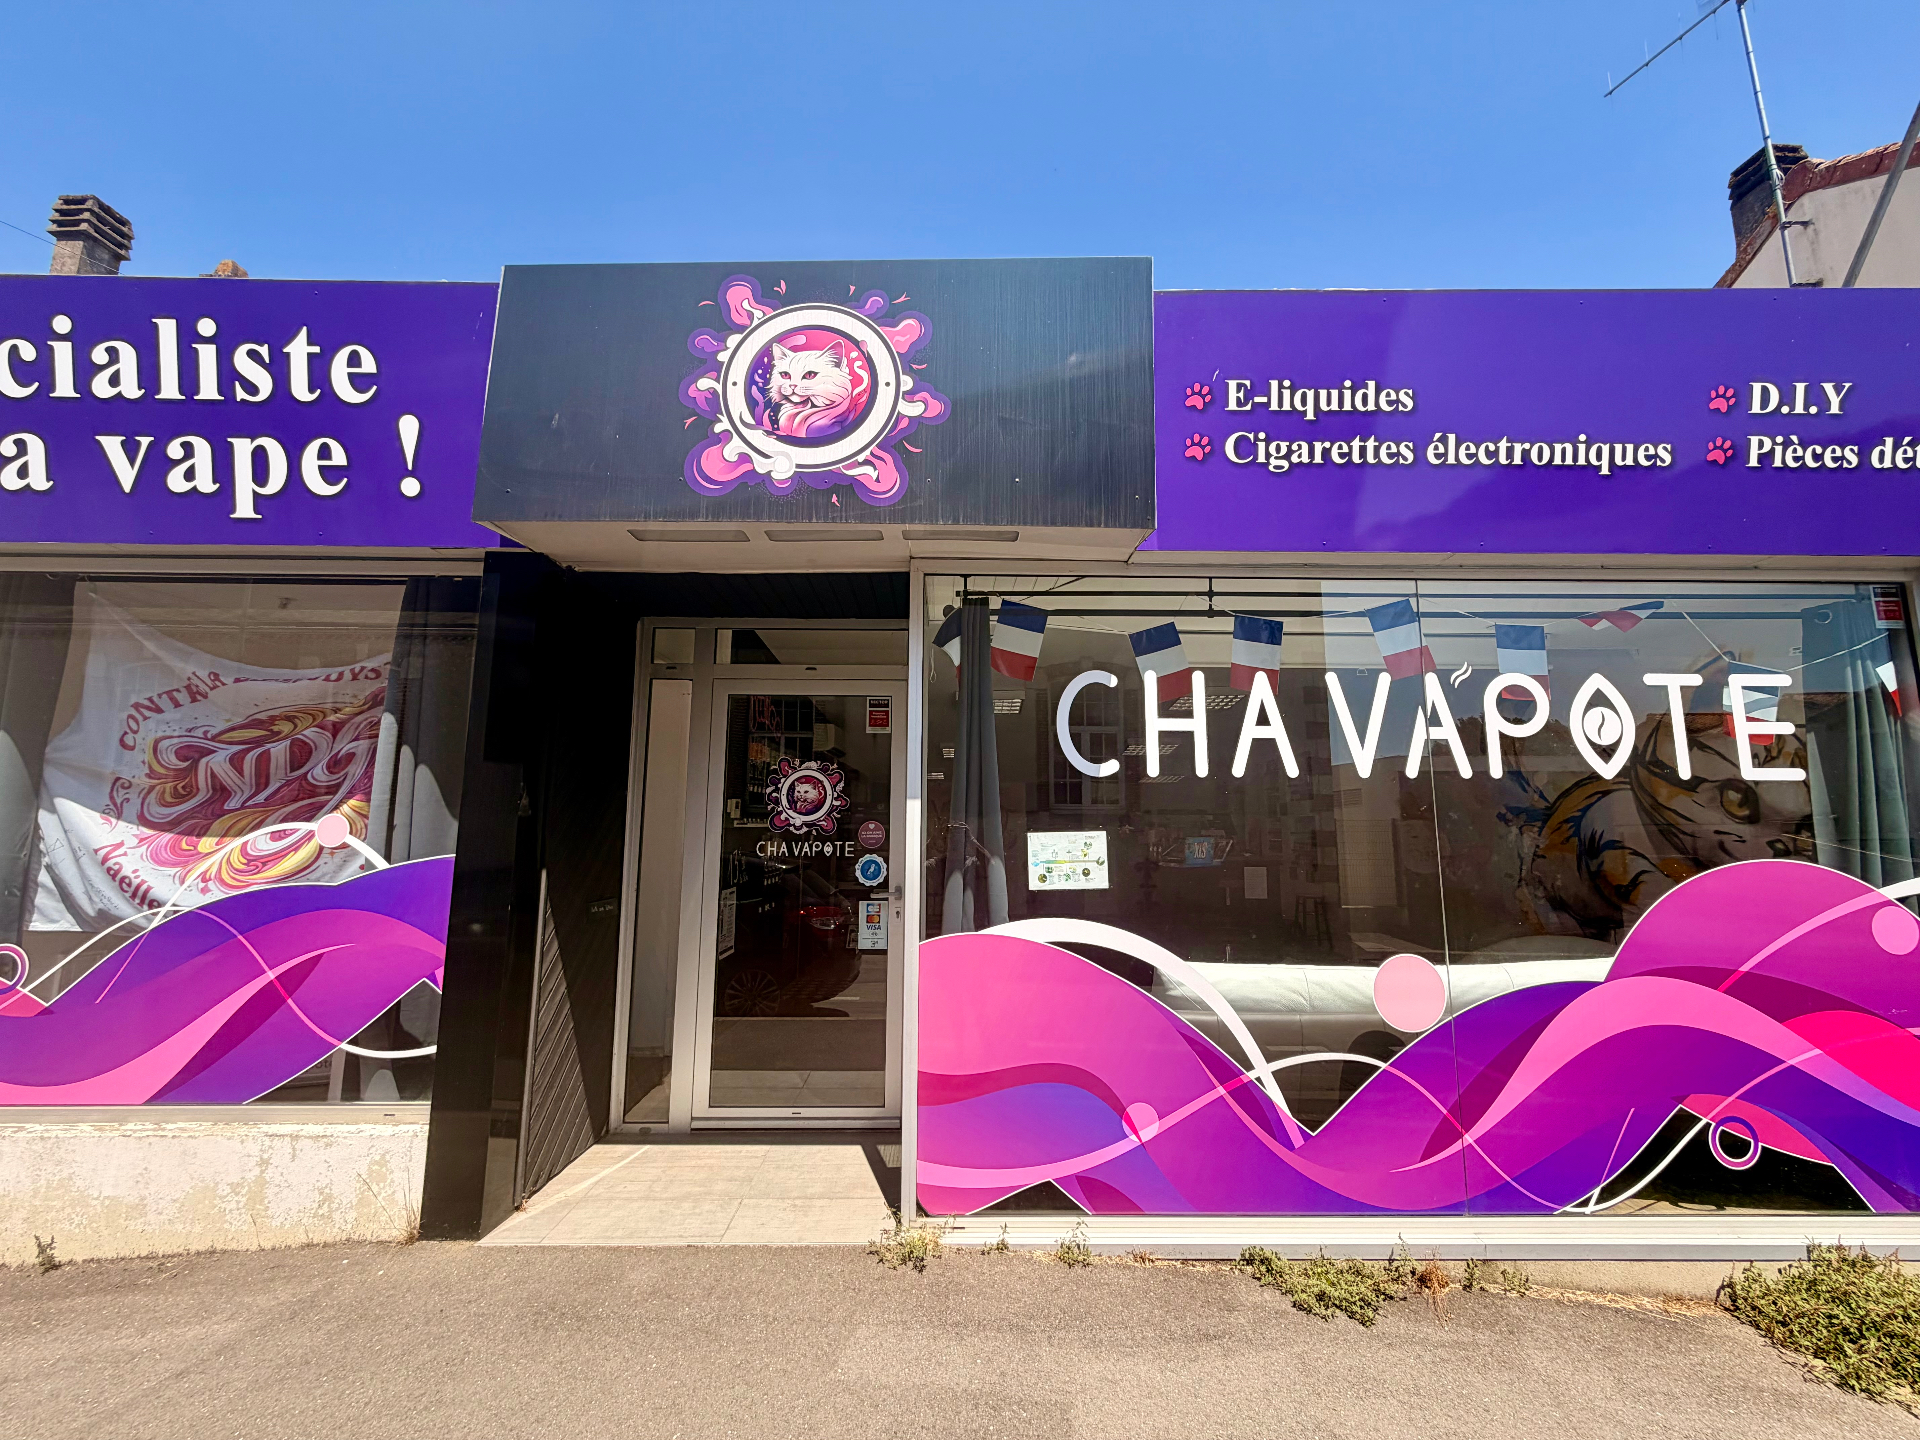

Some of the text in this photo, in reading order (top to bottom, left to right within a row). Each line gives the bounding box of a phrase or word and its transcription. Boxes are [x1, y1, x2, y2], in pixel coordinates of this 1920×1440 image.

[0, 314, 378, 404] cialiste
[1224, 379, 1414, 420] E-liquides
[1747, 382, 1853, 415] D.I.Y
[0, 414, 421, 519] a vape !
[1224, 431, 1672, 475] Cigarettes électroniques
[1745, 435, 1859, 469] Pièces
